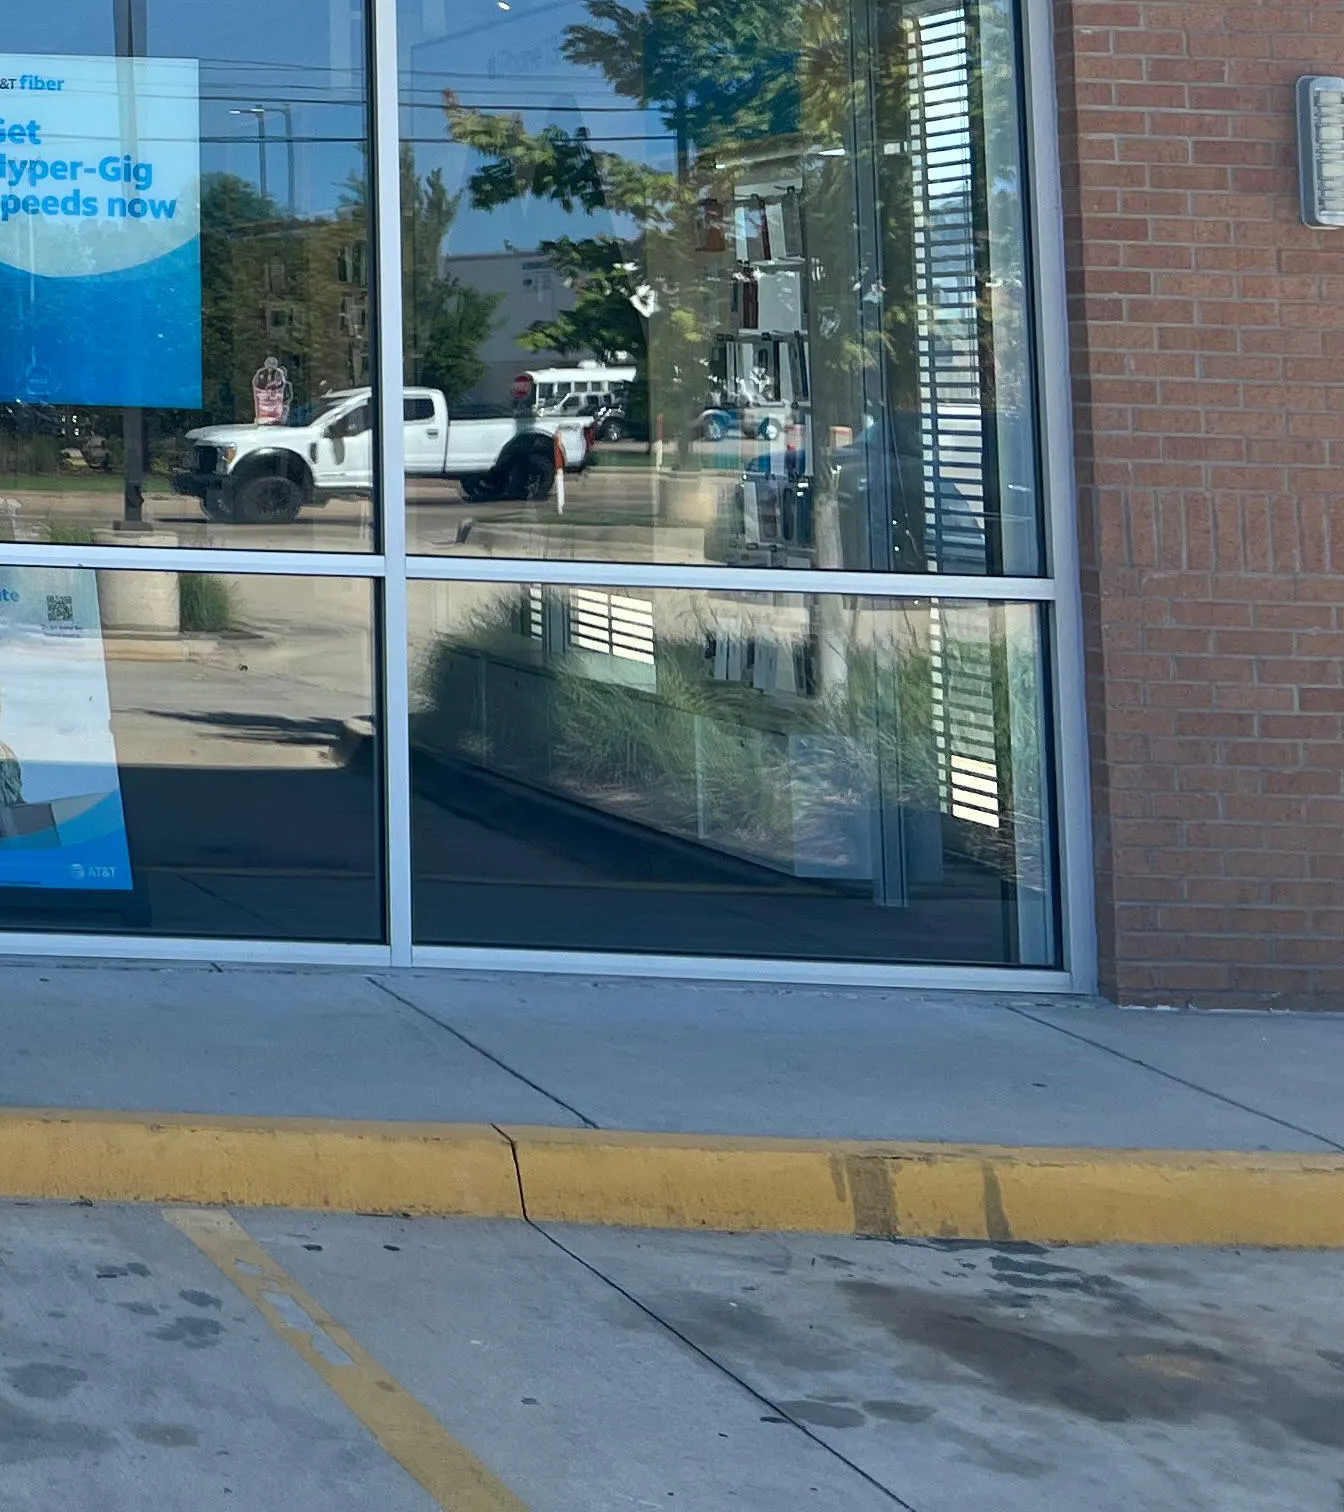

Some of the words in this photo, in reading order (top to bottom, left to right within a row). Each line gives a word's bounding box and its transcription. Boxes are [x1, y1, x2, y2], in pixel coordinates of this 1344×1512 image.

[19, 75, 64, 91] fiber
[107, 197, 177, 220] now
[88, 866, 117, 877] AT&T
